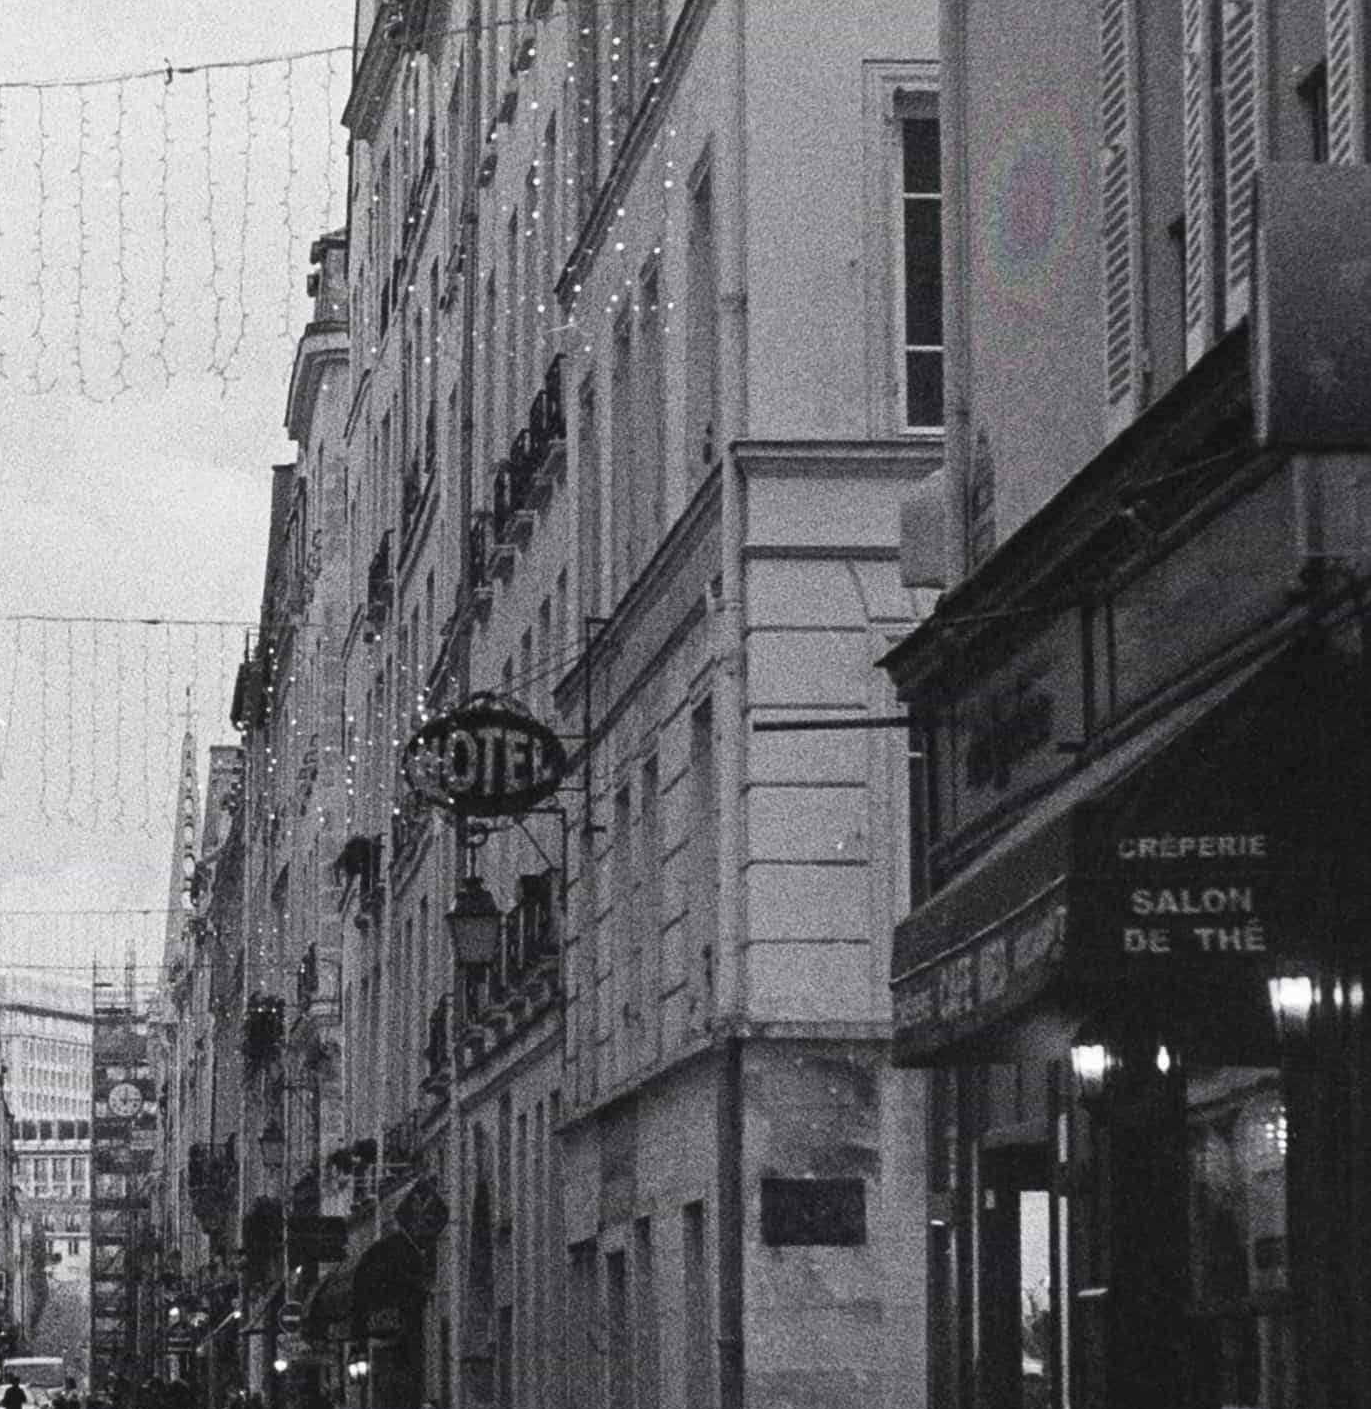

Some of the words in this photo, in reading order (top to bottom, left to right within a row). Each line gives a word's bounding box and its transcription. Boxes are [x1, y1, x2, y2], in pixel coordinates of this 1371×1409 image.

[1131, 887, 1252, 914] SALON
[1124, 927, 1171, 953] DE
[1193, 917, 1266, 951] THÉ
